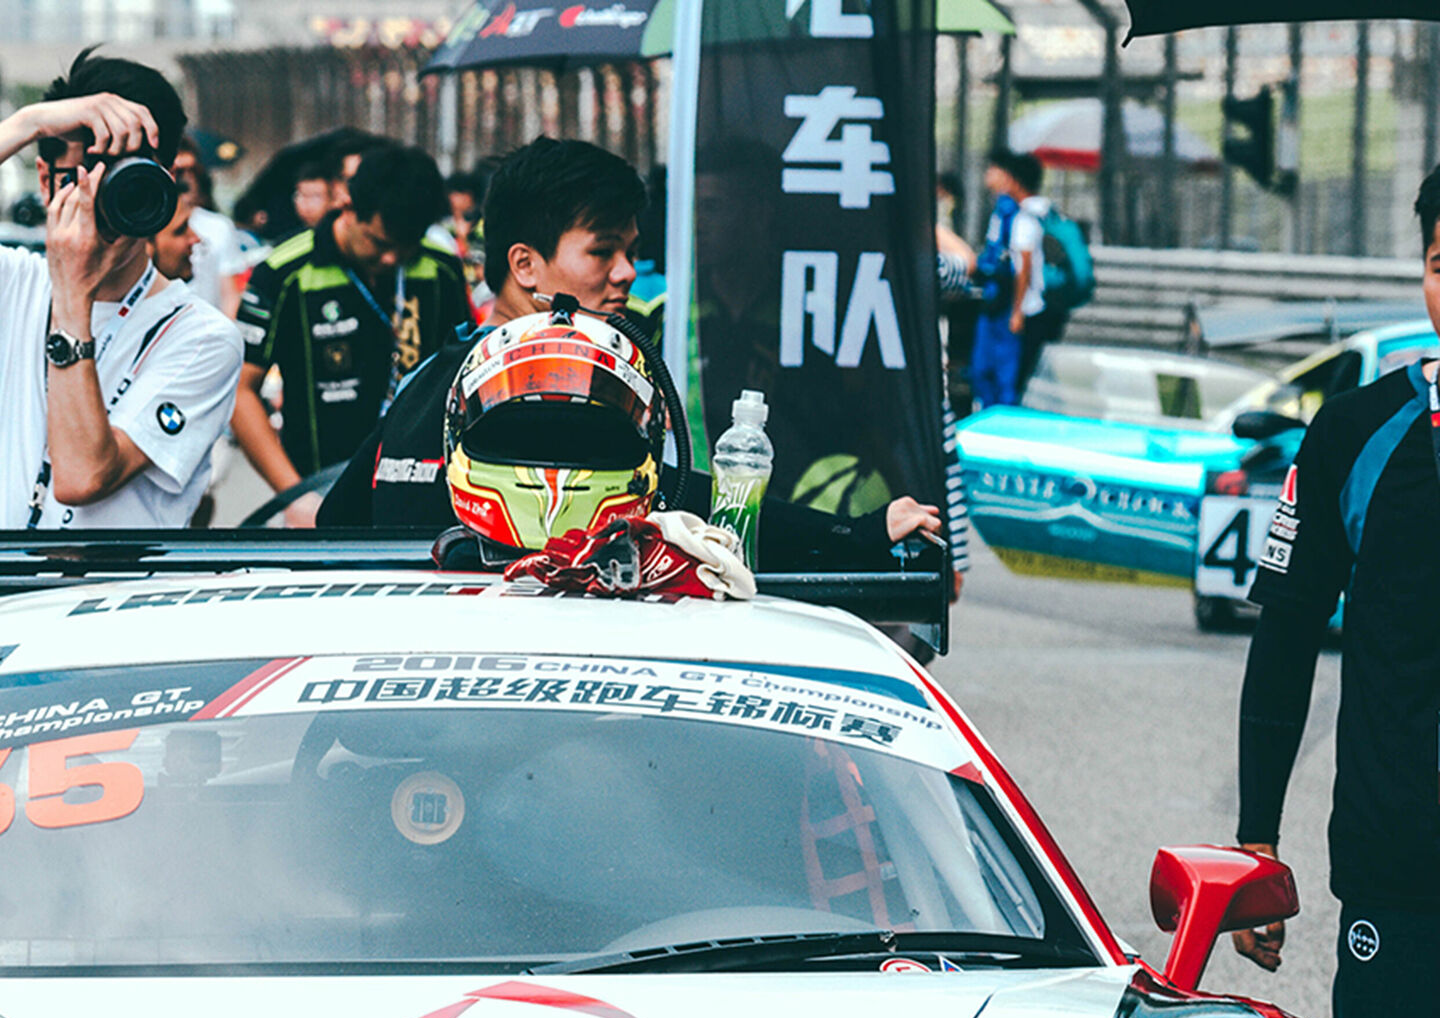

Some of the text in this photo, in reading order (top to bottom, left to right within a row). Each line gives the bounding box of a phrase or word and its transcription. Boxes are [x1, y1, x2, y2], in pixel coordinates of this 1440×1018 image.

[131, 687, 192, 707] GT
[298, 676, 903, 746] 中国超级跑车锦标赛
[353, 655, 944, 731] 2016 CHINA GT Championship
